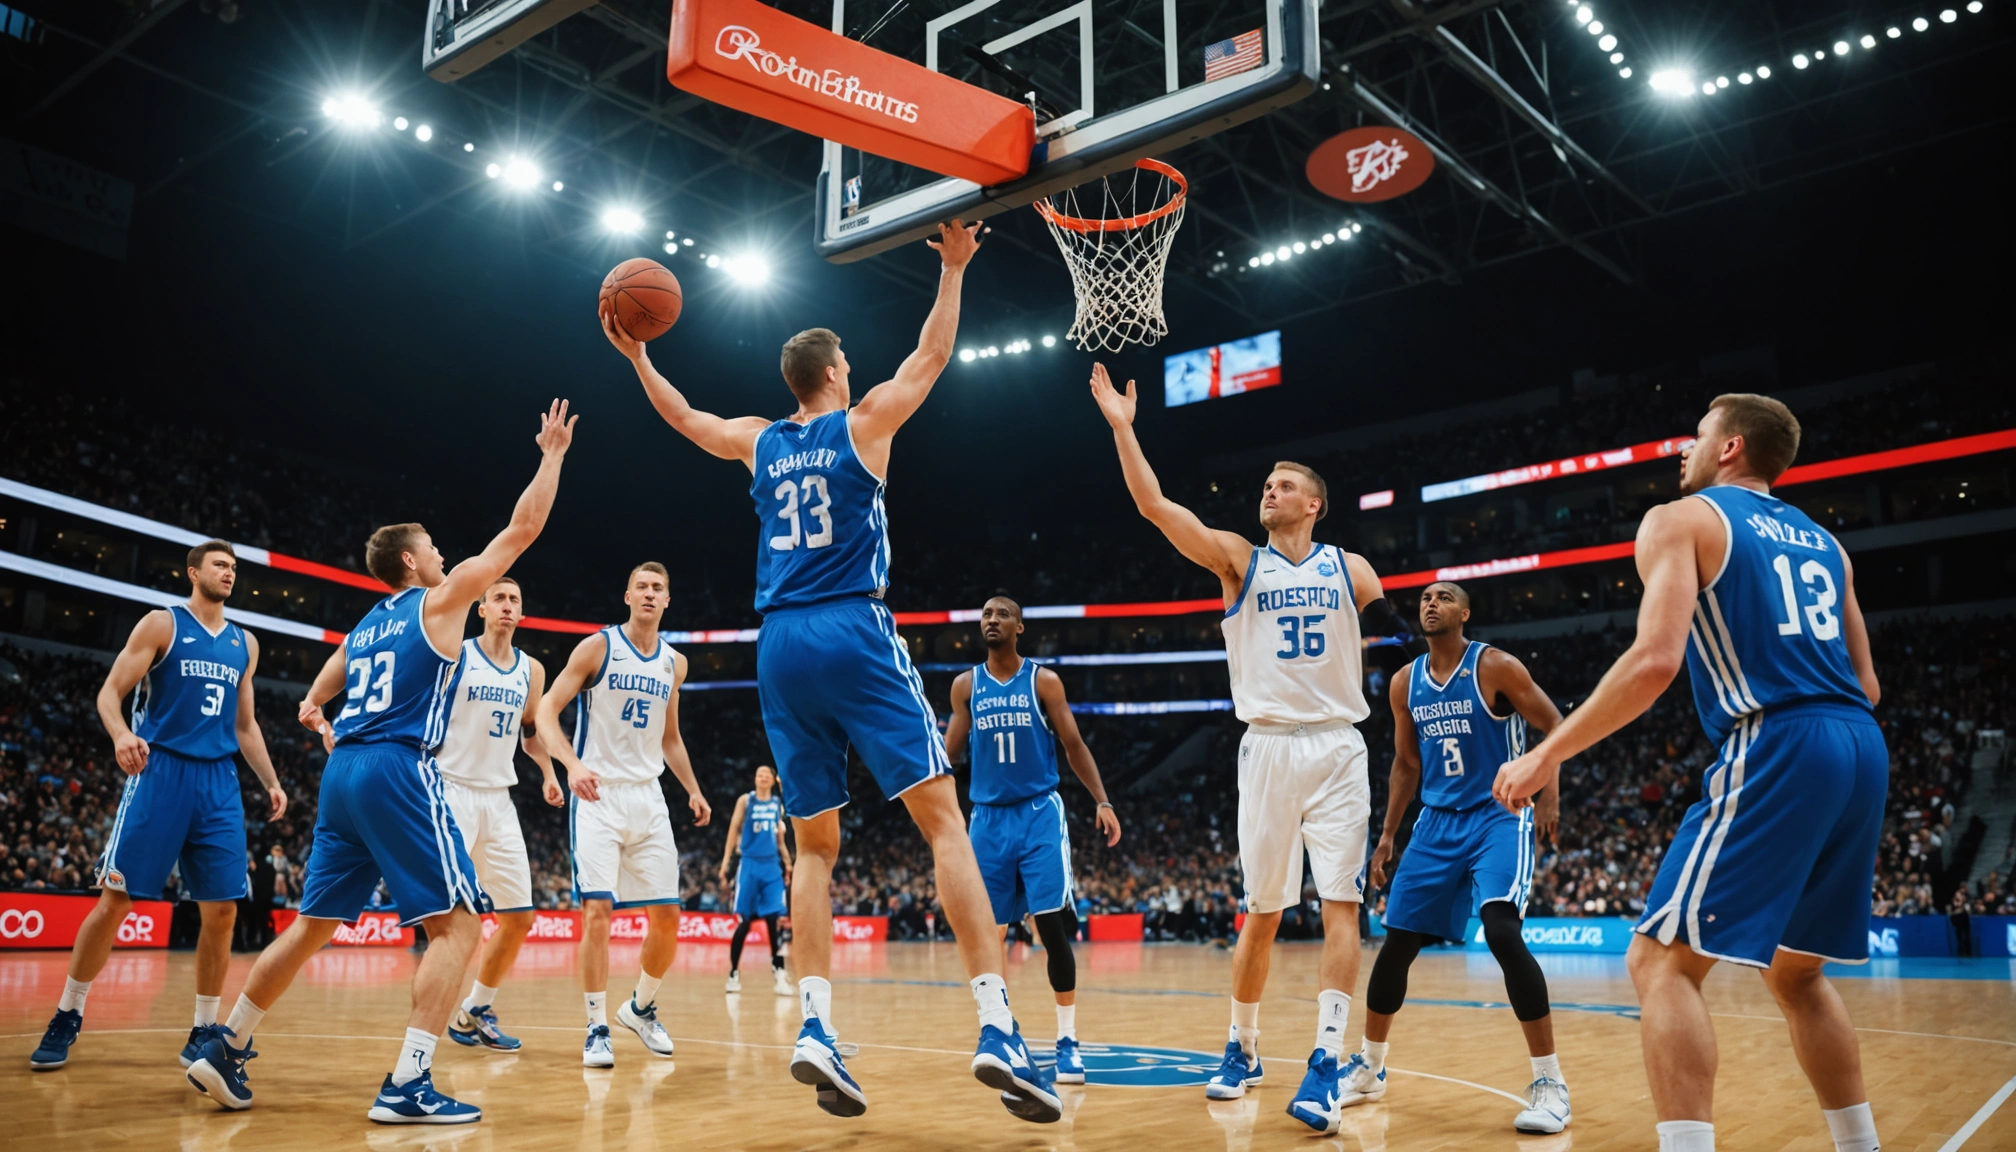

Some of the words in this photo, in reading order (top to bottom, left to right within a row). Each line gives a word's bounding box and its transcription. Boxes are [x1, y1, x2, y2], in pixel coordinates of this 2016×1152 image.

[769, 474, 833, 551] 33
[341, 651, 396, 720] 23
[621, 697, 651, 729] 45
[993, 731, 1016, 764] 11
